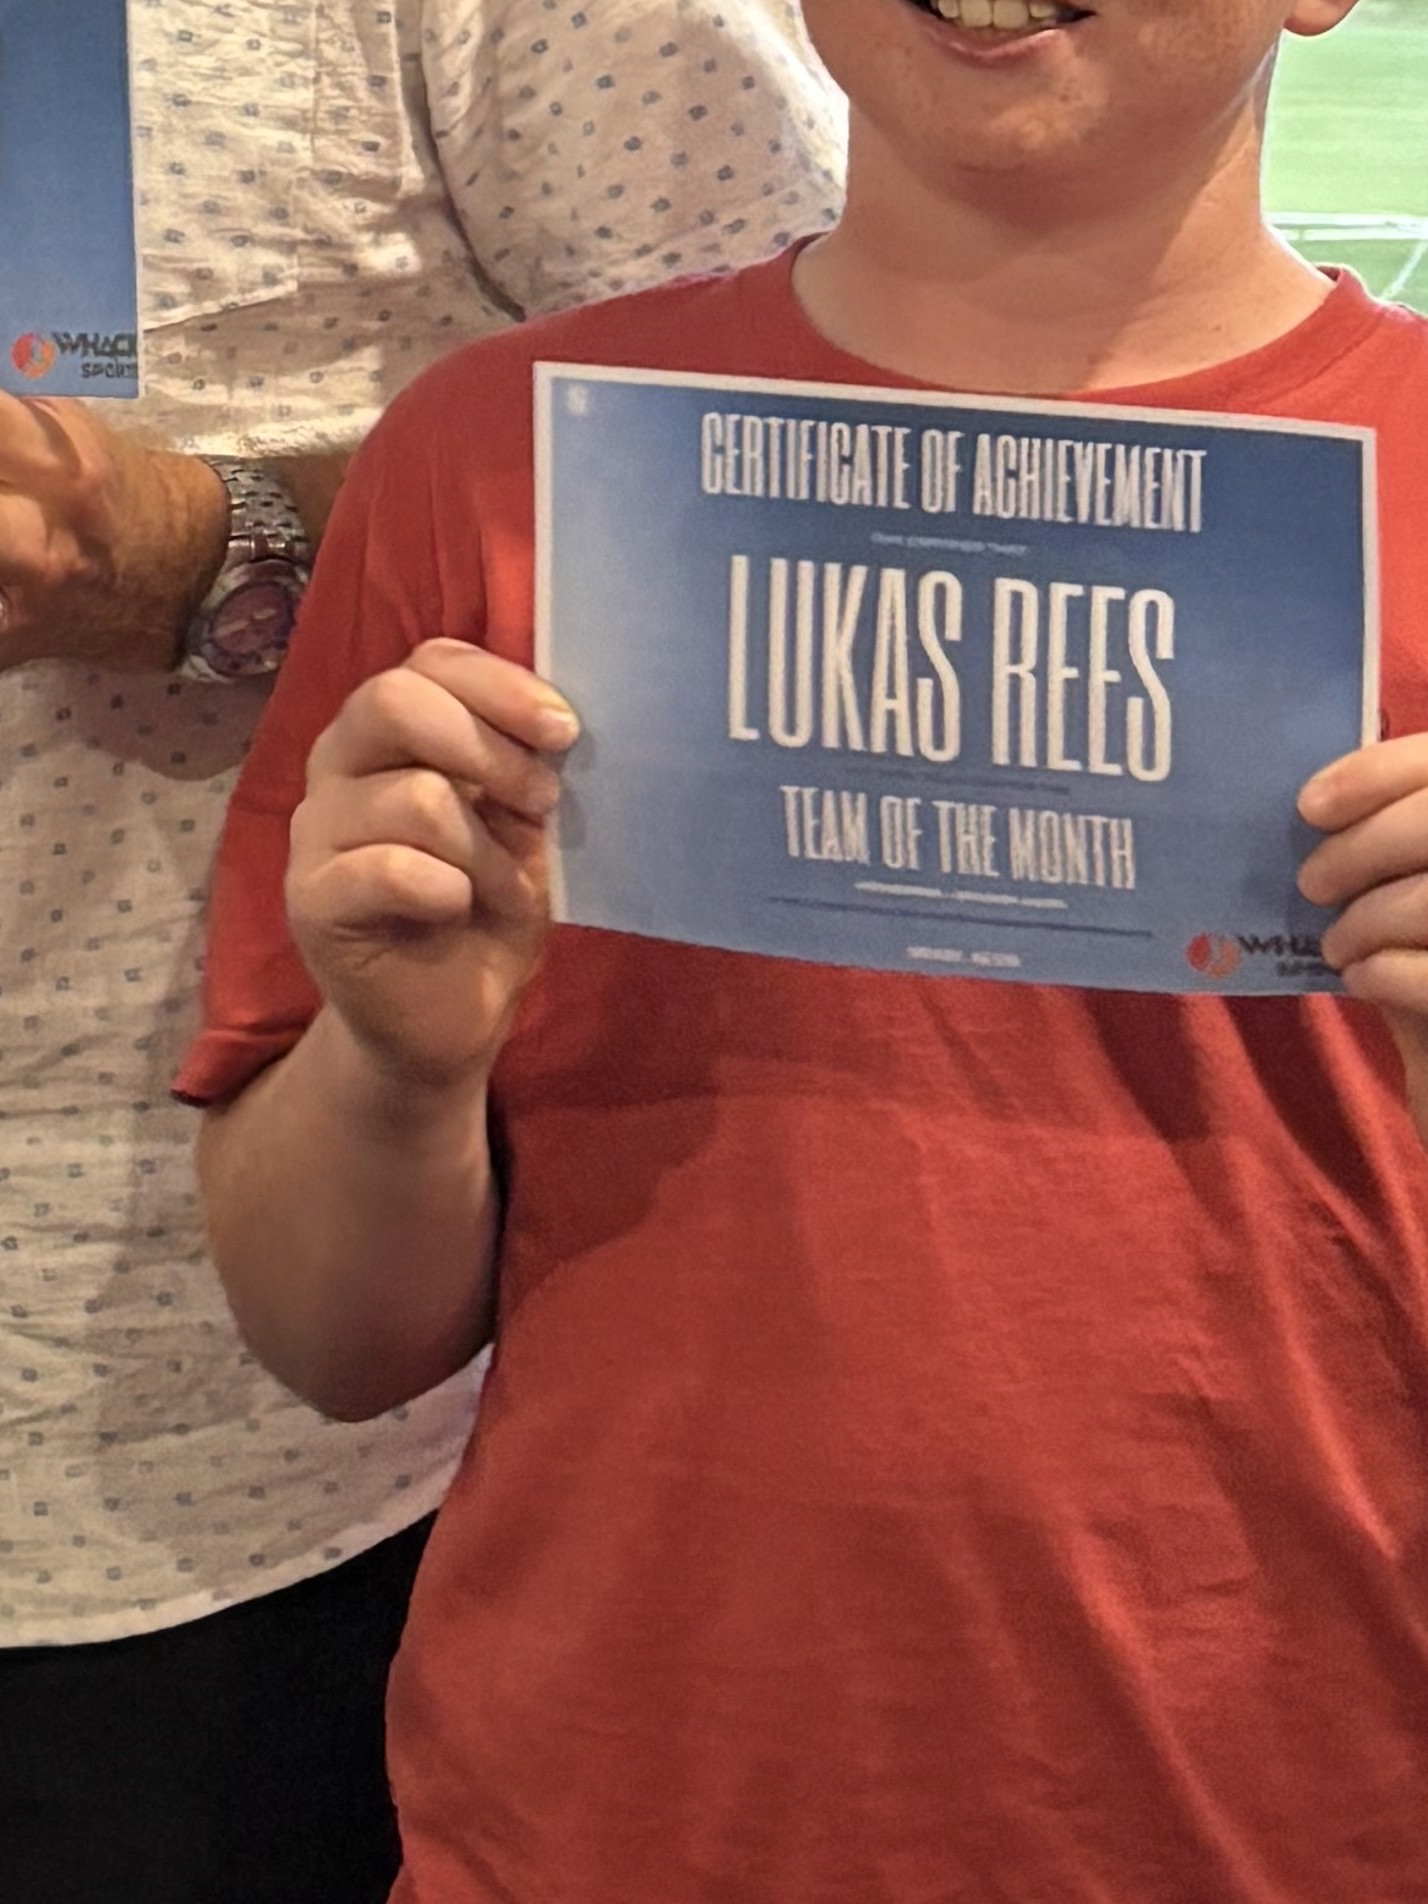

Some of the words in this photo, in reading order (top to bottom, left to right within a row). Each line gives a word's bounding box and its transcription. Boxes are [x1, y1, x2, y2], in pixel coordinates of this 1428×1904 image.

[51, 331, 137, 357] WHAC
[702, 413, 911, 512] CERTIFICATE
[922, 428, 963, 514] OF
[973, 433, 1207, 534] ACHIEVEMENT
[728, 554, 963, 764] LUKAS
[993, 577, 1176, 783] REES
[781, 784, 868, 862] TEAM
[882, 797, 923, 872] OF
[934, 801, 1001, 879] THE
[1009, 808, 1136, 891] MONTH
